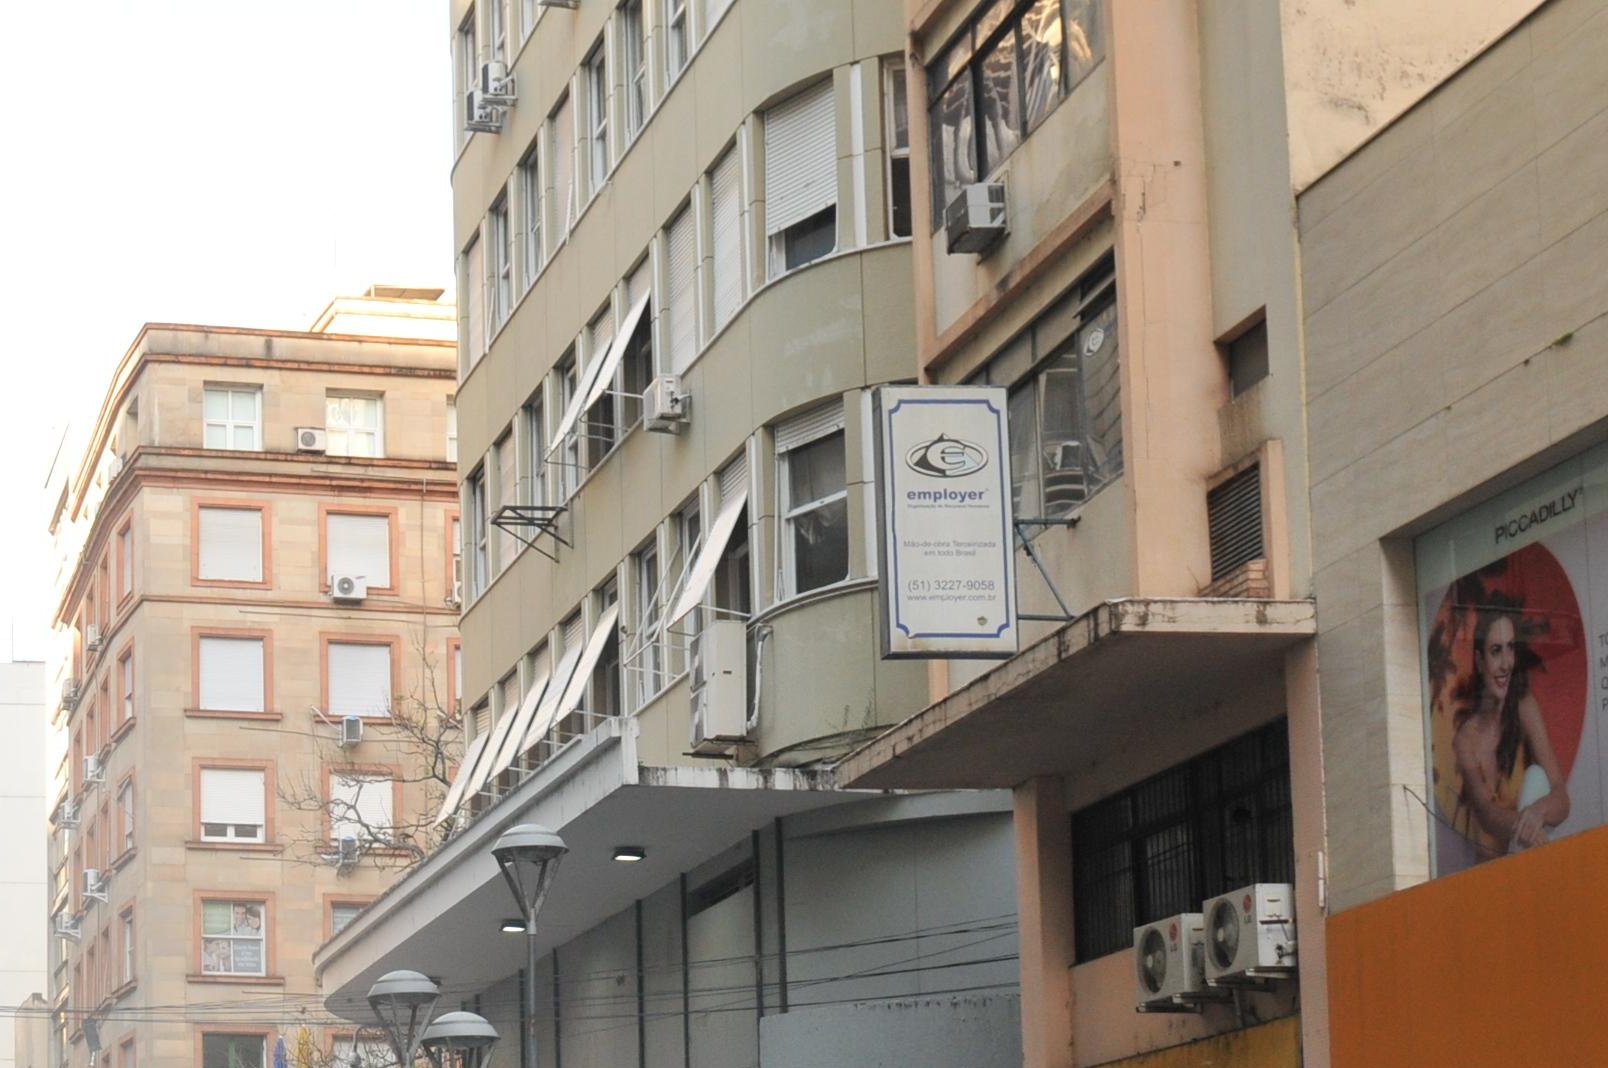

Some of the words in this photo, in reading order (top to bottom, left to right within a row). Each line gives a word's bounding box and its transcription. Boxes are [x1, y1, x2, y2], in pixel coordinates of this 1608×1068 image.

[906, 488, 985, 503] employer
[1495, 489, 1579, 545] PICCADILLY
[907, 580, 931, 593] (51)
[934, 580, 996, 591] 3227-9058
